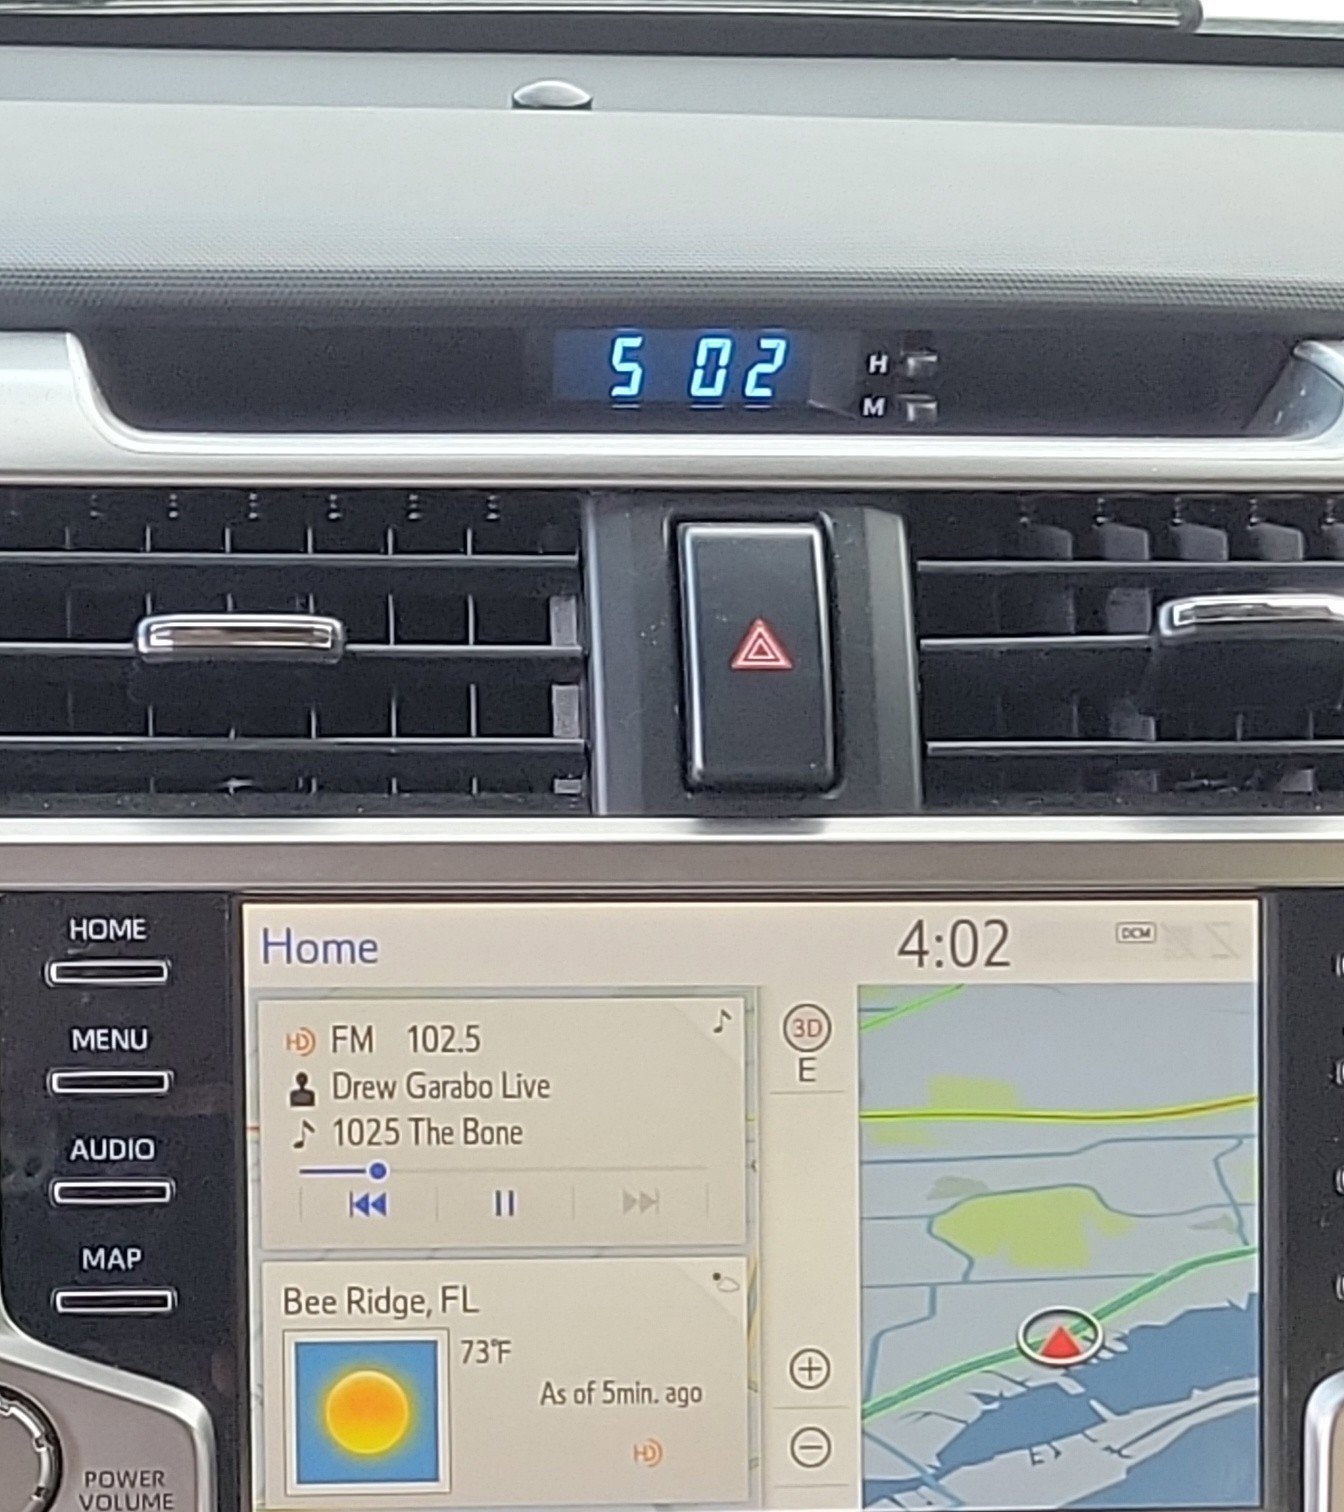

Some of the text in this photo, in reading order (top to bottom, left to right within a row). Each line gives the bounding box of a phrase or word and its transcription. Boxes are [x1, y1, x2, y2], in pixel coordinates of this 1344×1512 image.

[869, 354, 888, 373] H
[863, 397, 885, 416] M
[70, 918, 147, 940] HOME
[262, 926, 378, 965] Home
[897, 918, 1011, 968] 4:02
[72, 1028, 148, 1051] MENU
[332, 1024, 481, 1054] FM 102.5
[792, 1018, 824, 1038] 3D
[798, 1056, 817, 1083] E
[333, 1070, 551, 1101] Drew Garabo Live
[333, 1116, 524, 1147] 1025 The Bone
[70, 1138, 155, 1161] AUDIO
[82, 1247, 142, 1270] MAP
[283, 1284, 480, 1321] Bee Ridge, FL
[539, 1379, 703, 1409] As of 5min. ago
[84, 1469, 166, 1489] POWER
[78, 1492, 175, 1512] VOLUME
